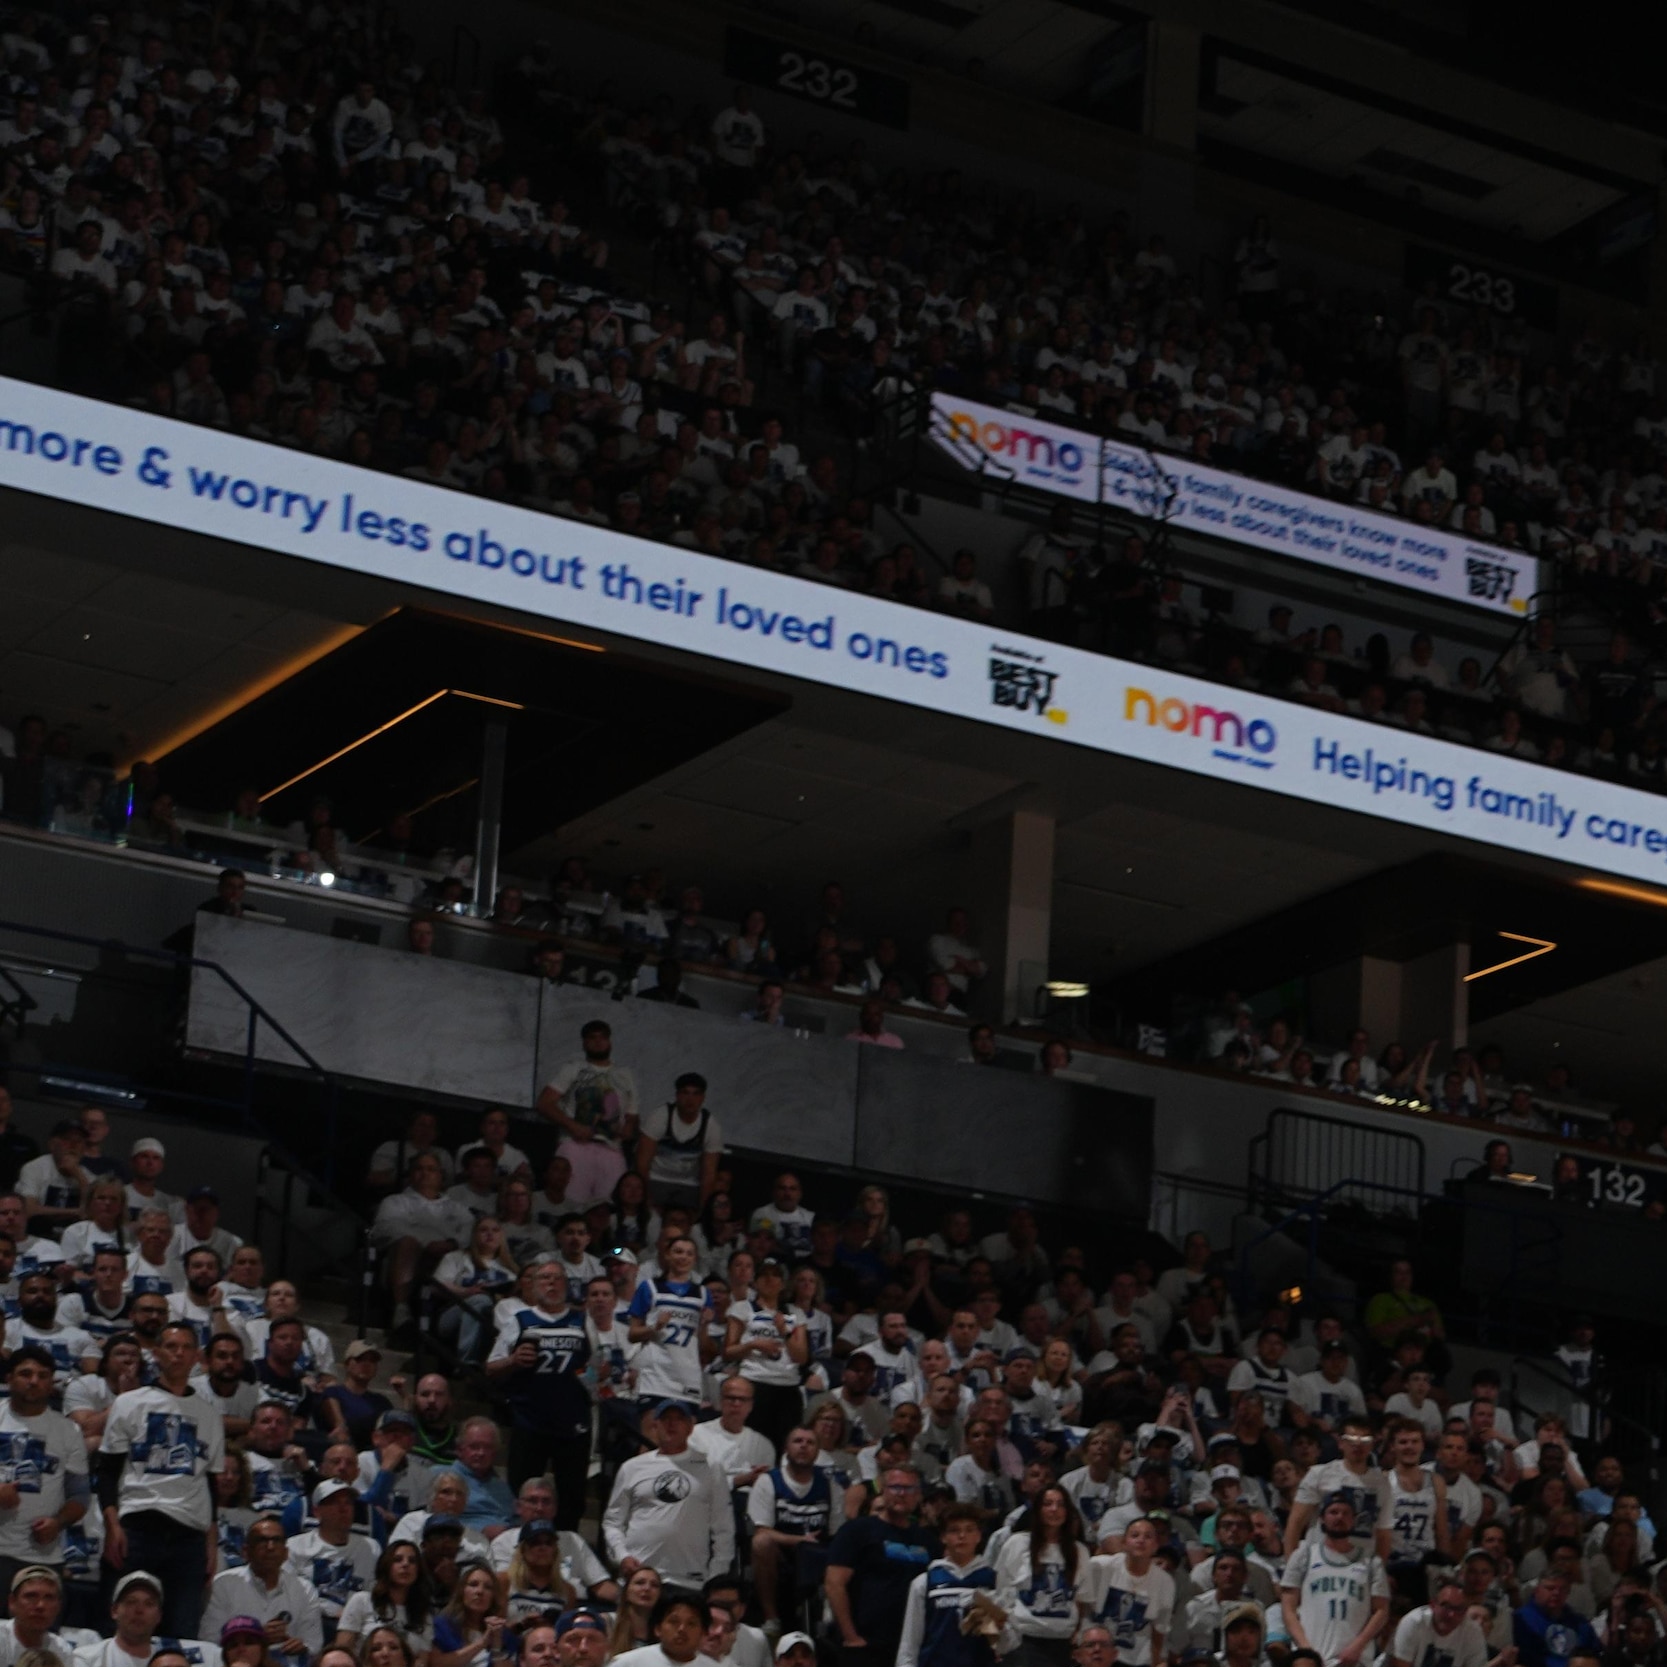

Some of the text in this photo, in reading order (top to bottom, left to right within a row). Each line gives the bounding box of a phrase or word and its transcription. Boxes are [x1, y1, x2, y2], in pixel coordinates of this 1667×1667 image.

[778, 52, 859, 108] 232
[1451, 264, 1515, 313] 233
[0, 419, 950, 680] more & worry less about their loved ones
[988, 657, 1060, 695] BEST
[991, 681, 1049, 716] BUY
[1123, 685, 1277, 754] nomo
[1312, 737, 1456, 812] Helping
[1466, 775, 1578, 840] family
[1587, 1167, 1646, 1208] 132
[664, 1324, 695, 1347] 27
[536, 1349, 575, 1375] 27
